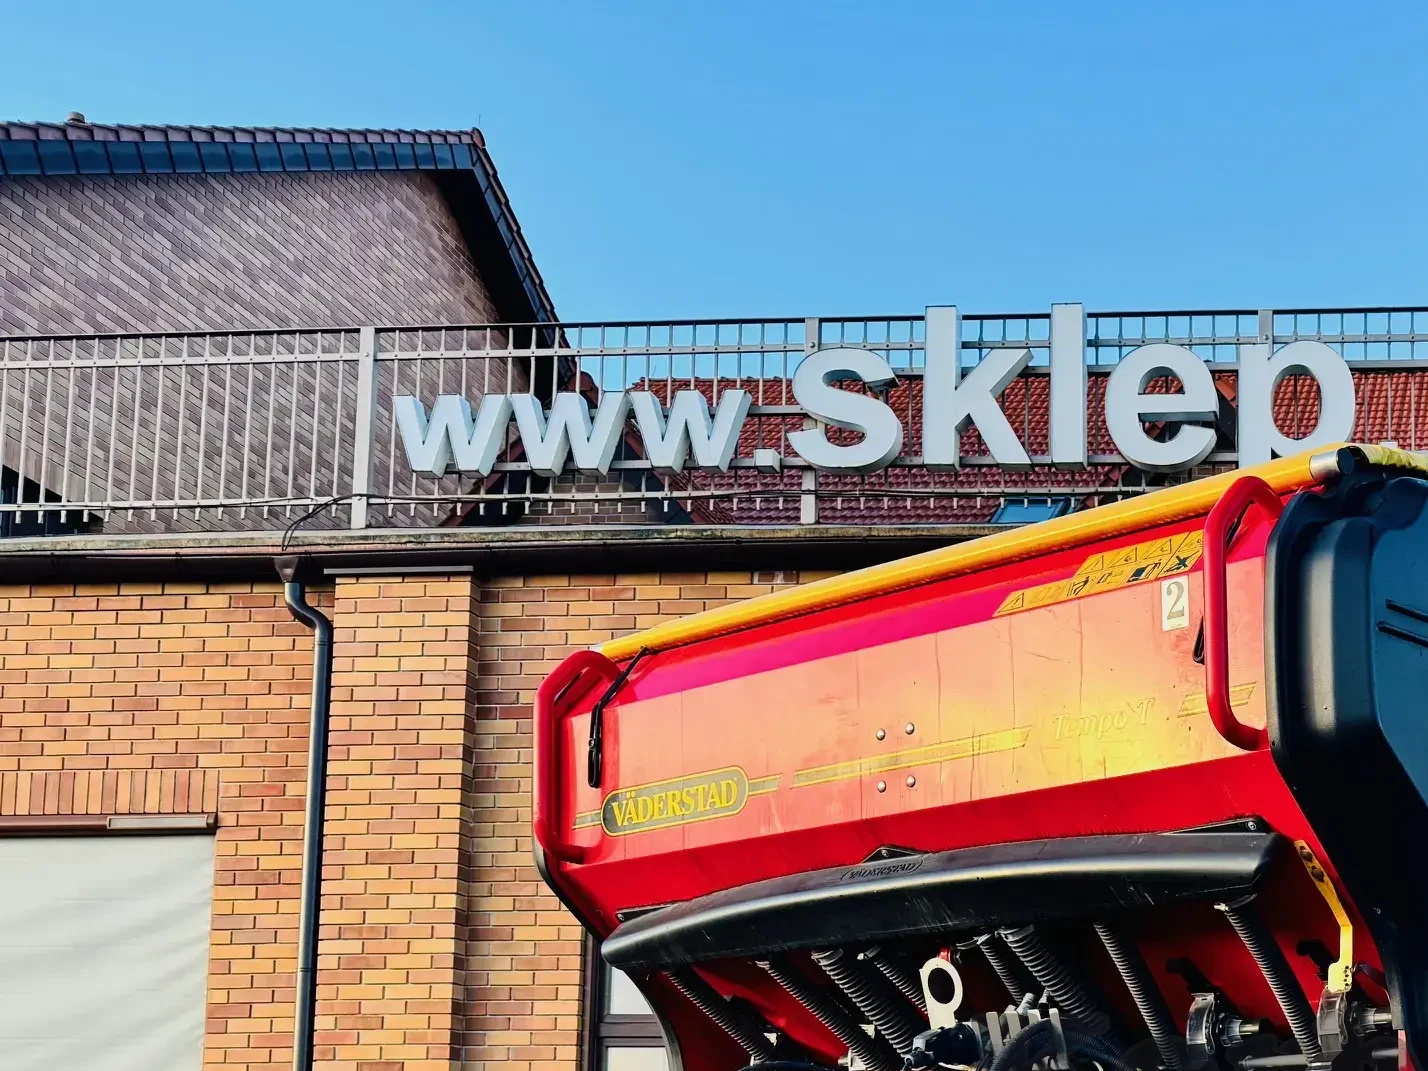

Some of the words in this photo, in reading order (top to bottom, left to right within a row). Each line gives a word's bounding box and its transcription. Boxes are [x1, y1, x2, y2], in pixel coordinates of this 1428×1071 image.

[1166, 581, 1185, 620] 2
[1052, 710, 1128, 741] Tempo
[612, 779, 738, 827] VÄDERSTAD
